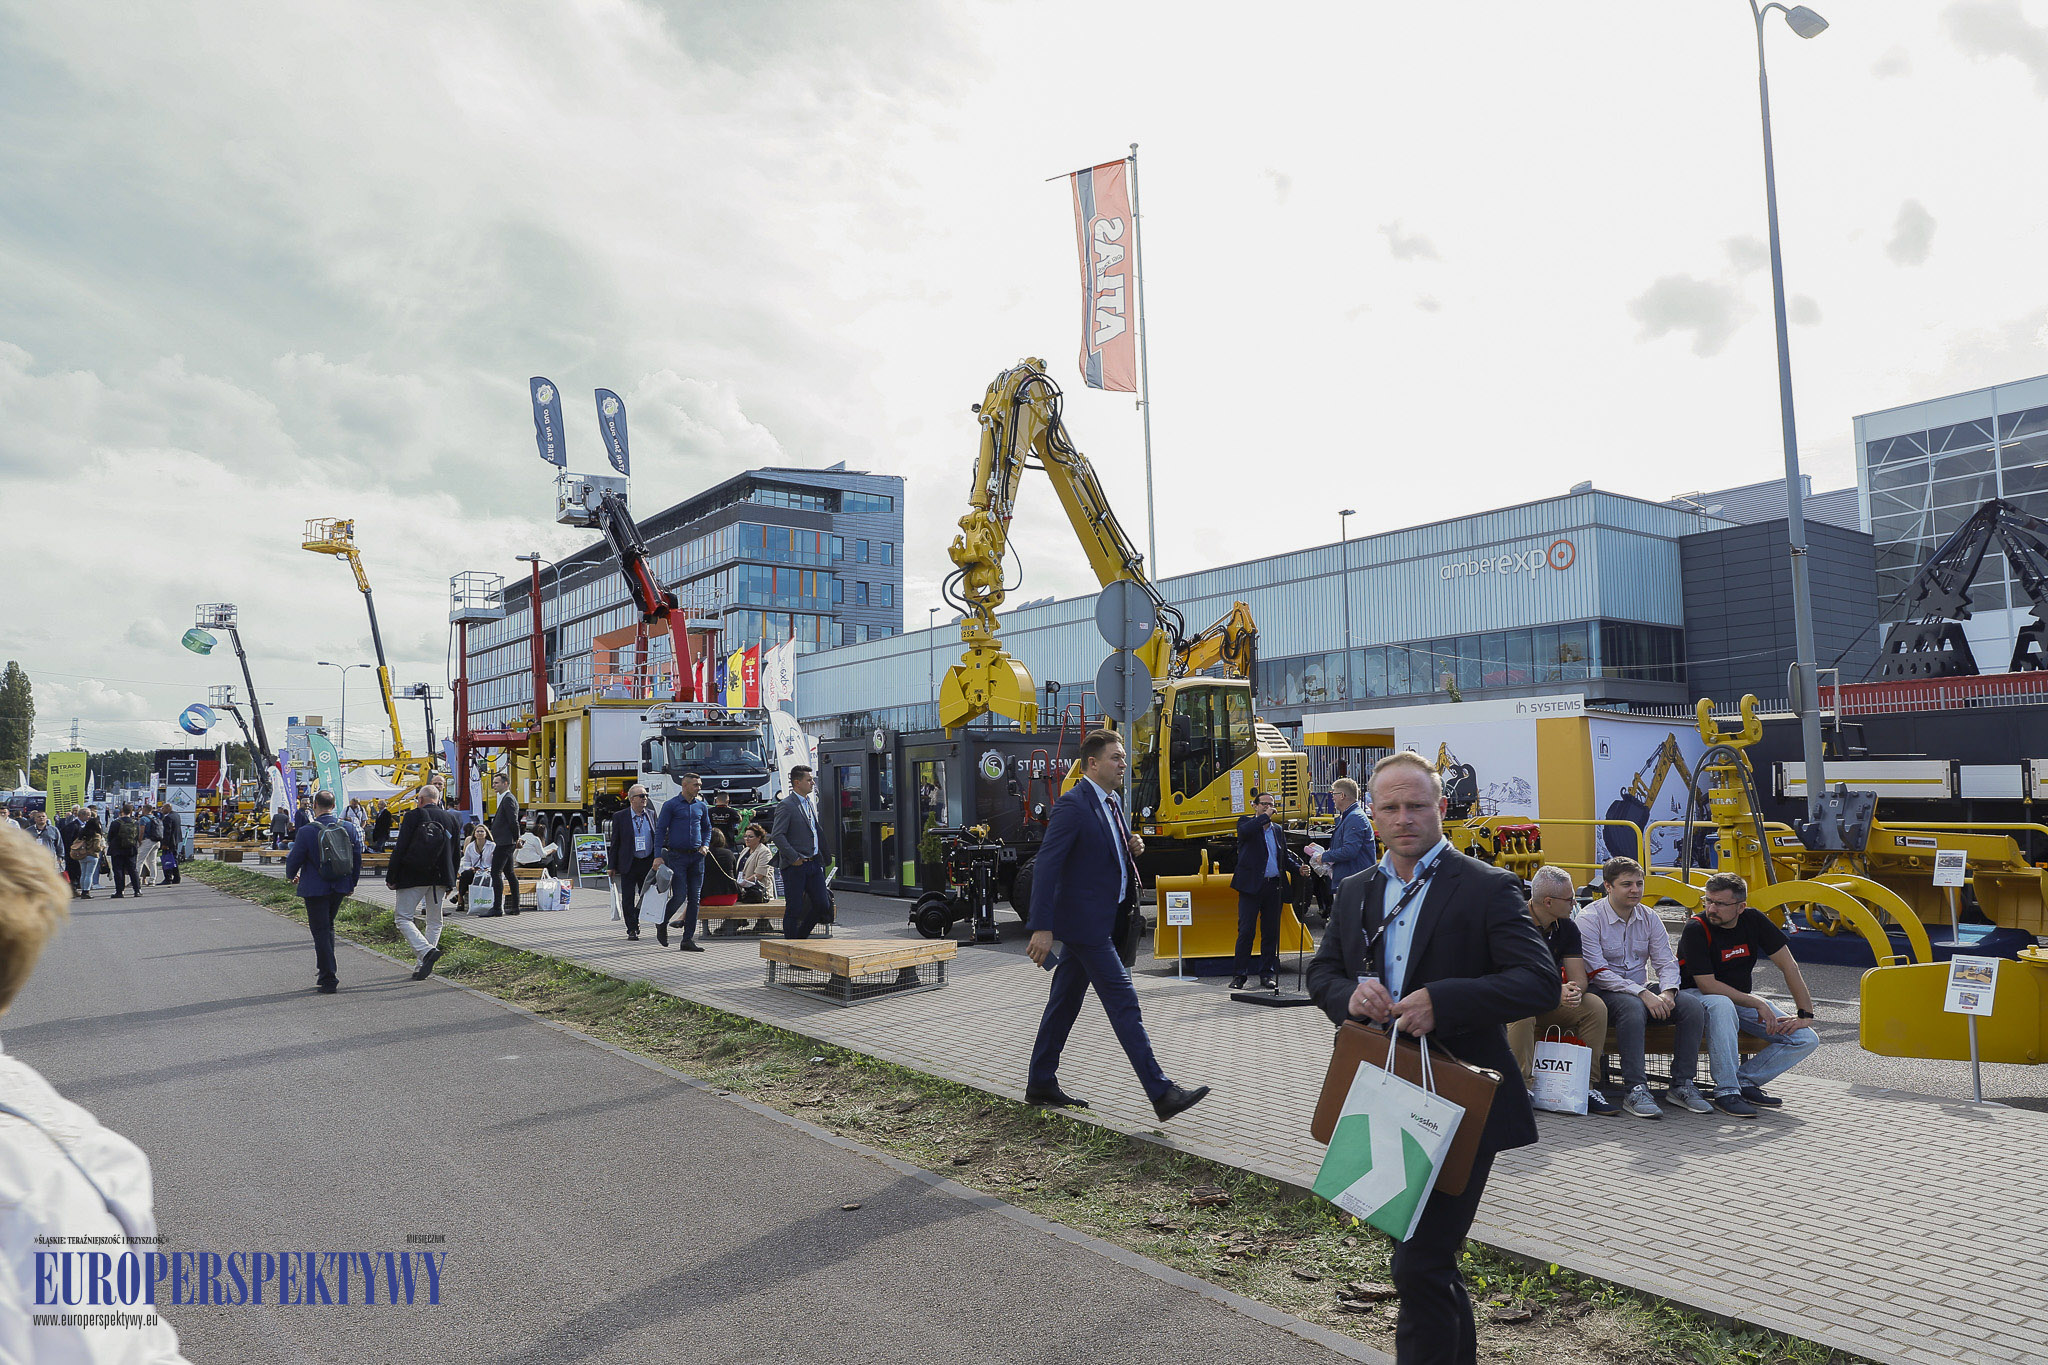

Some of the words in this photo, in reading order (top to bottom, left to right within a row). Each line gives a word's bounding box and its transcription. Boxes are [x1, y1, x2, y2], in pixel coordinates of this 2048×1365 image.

[1531, 701, 1581, 713] SYSTEMS
[1017, 759, 1046, 771] STAR
[1534, 1058, 1573, 1072] ASTAT
